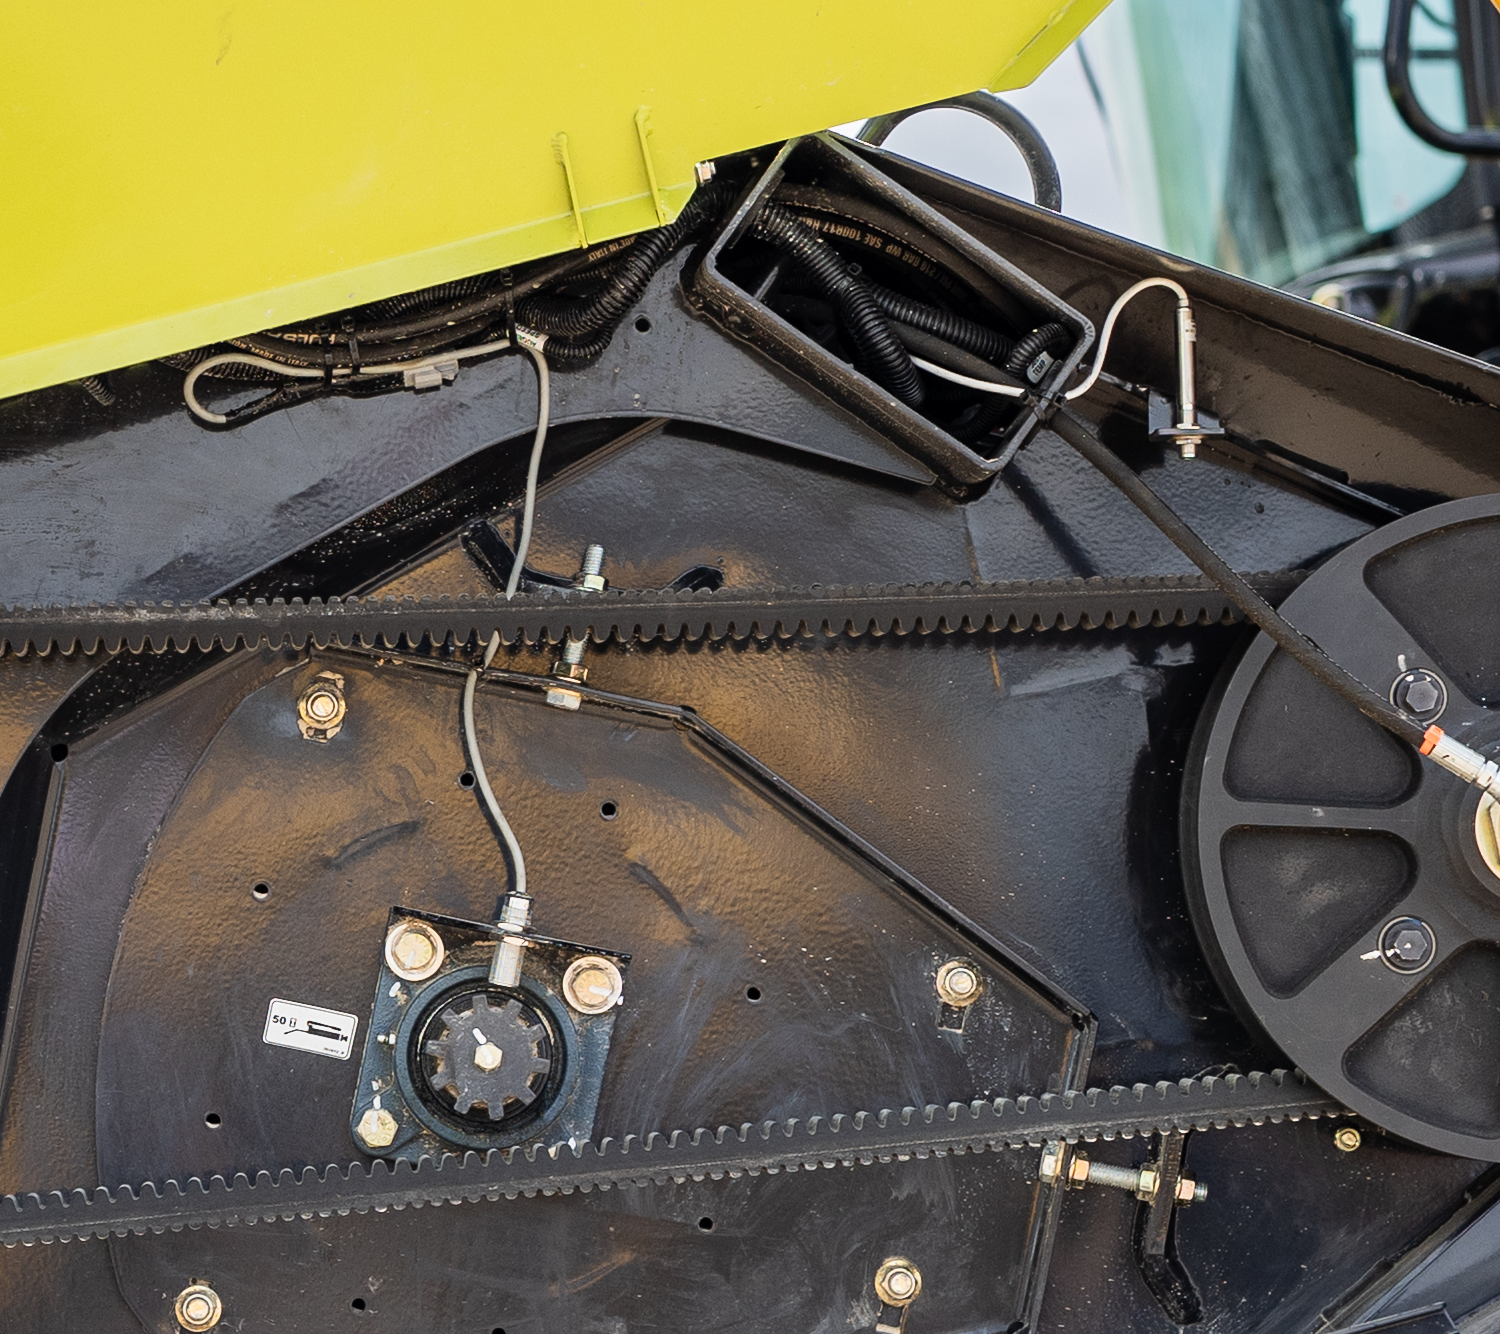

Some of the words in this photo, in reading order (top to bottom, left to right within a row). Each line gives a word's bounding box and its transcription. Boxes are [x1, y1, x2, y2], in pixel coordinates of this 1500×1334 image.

[618, 235, 637, 250] ADE
[864, 233, 883, 248] SAE
[272, 1015, 286, 1024] 50
